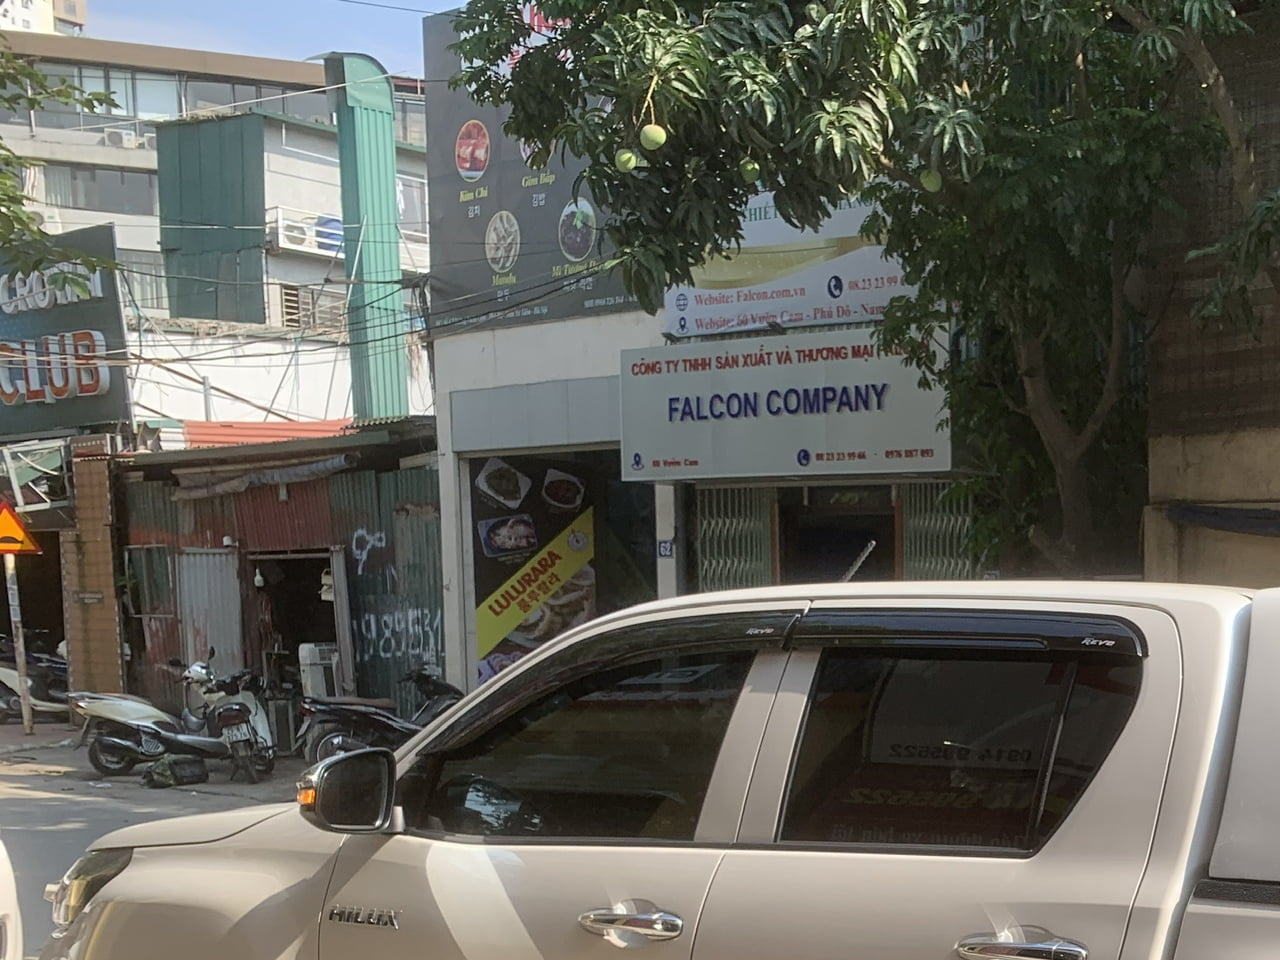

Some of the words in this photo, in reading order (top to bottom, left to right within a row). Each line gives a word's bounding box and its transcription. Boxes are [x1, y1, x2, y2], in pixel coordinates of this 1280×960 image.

[694, 293, 734, 306] Website:
[736, 287, 806, 302] Falcon.com.vn
[695, 318, 735, 330] Website:
[0, 330, 110, 405] CLUB
[631, 358, 662, 376] CÔNG
[665, 357, 679, 374] TY
[682, 357, 712, 373] TNHH
[741, 344, 773, 367] XUẤT
[776, 345, 793, 365] VÀ
[851, 344, 874, 362] MẠI
[668, 392, 757, 422] FALCON
[766, 383, 888, 416] COMPANY
[660, 542, 671, 556] 62
[487, 549, 562, 617] LULURARA
[328, 904, 403, 929] HILUX
